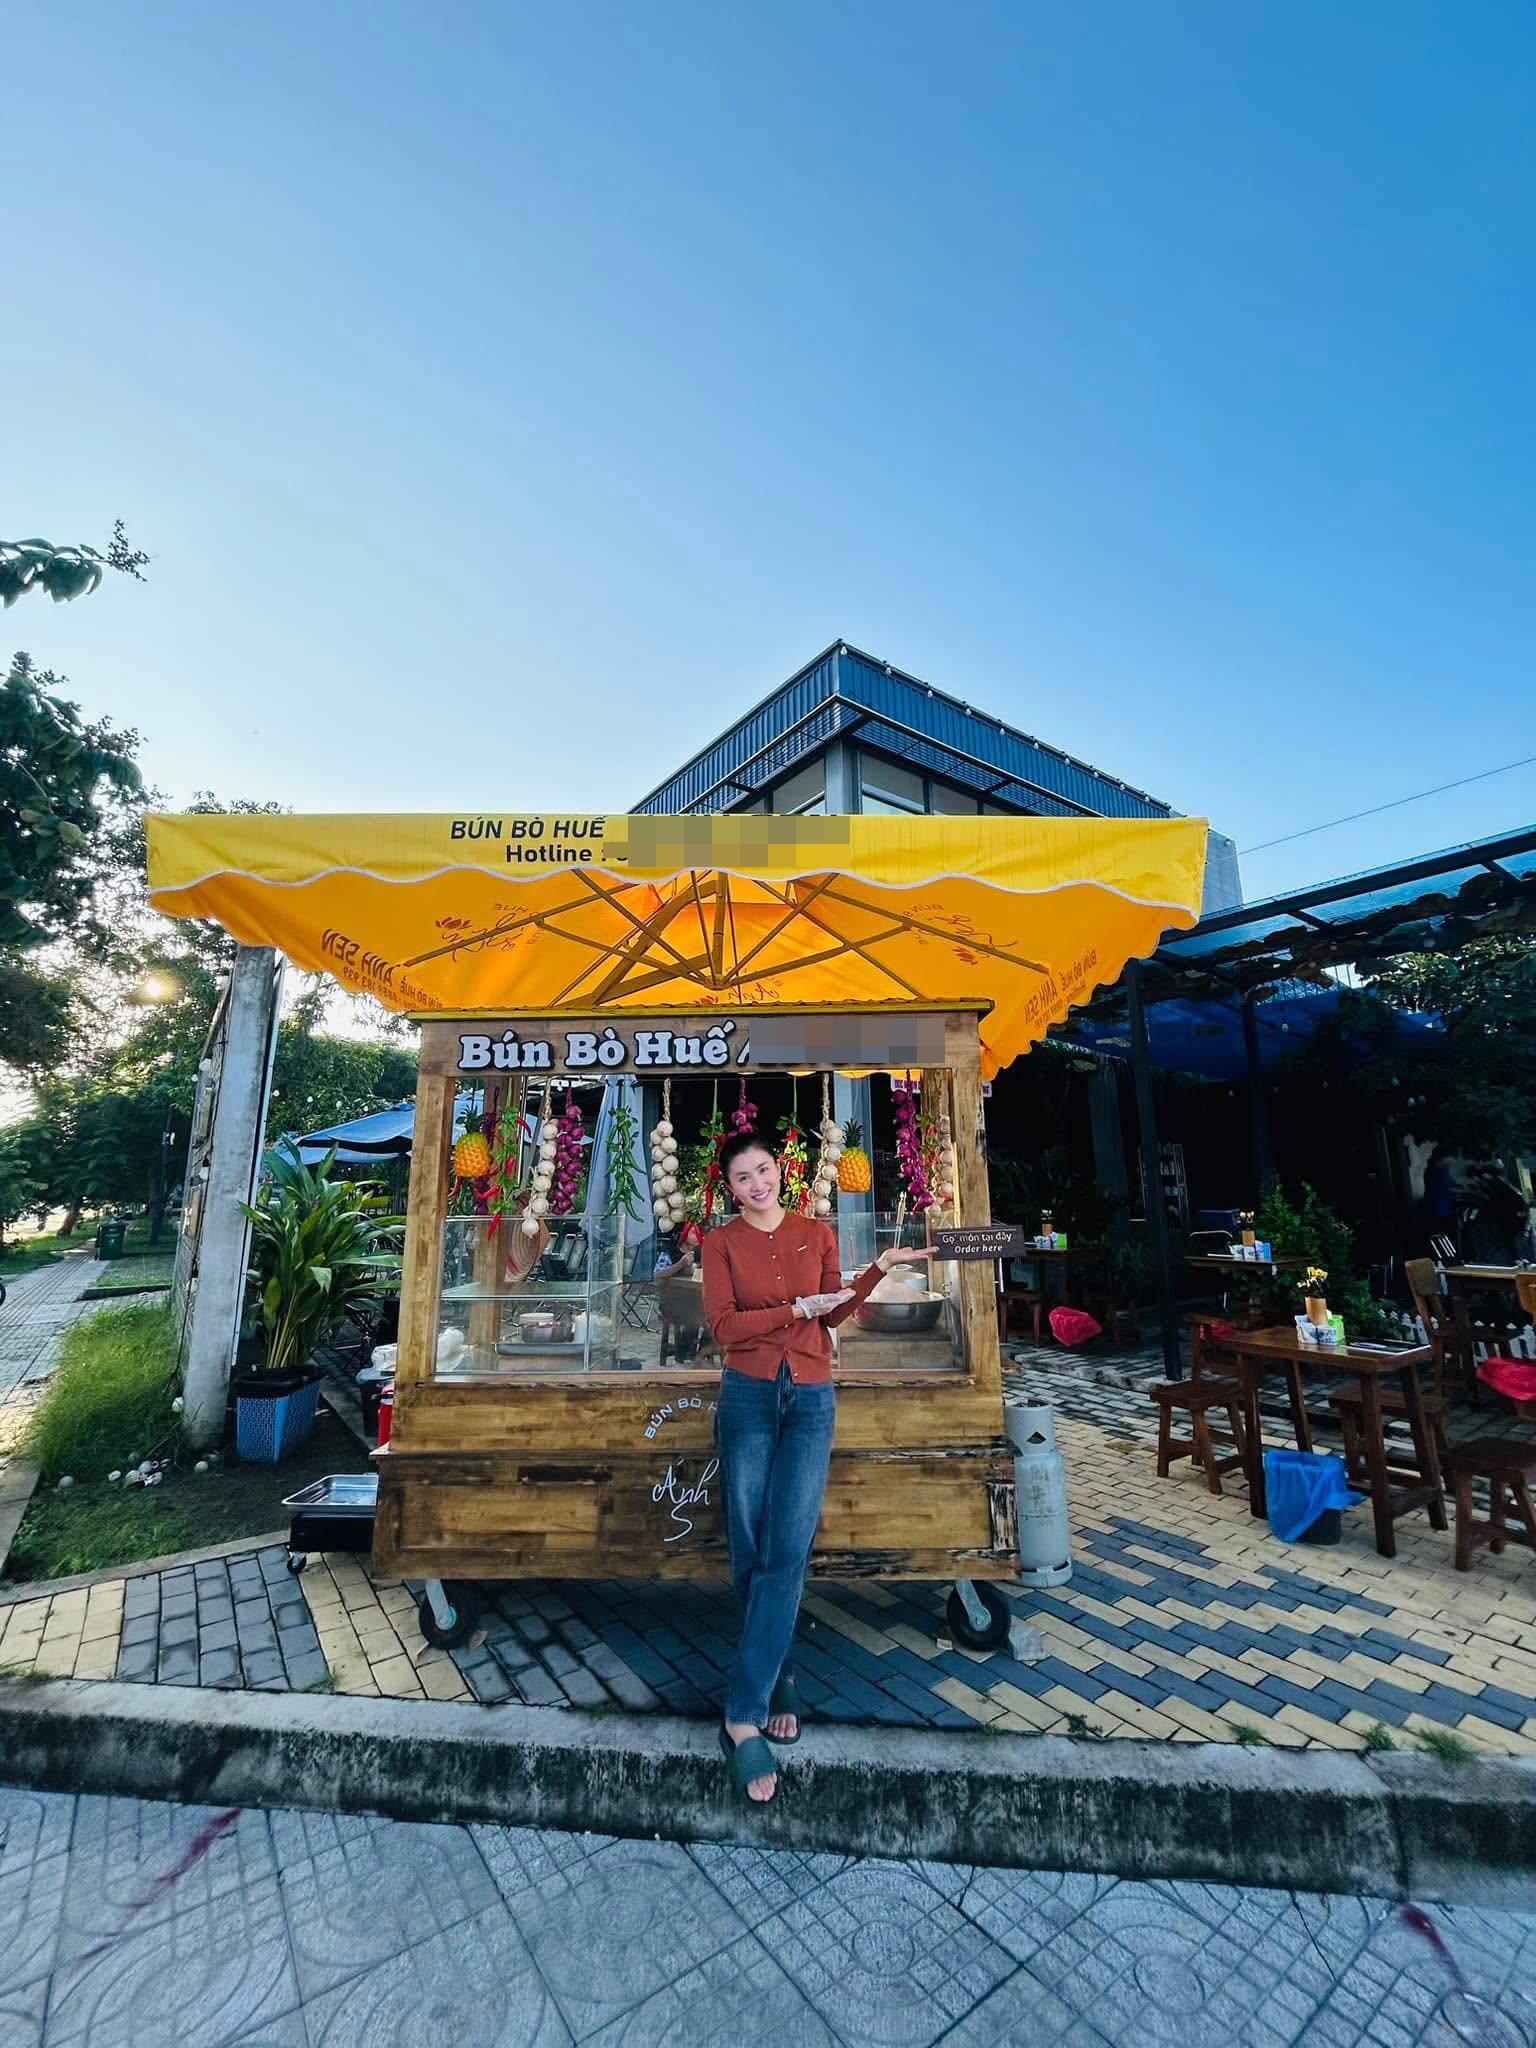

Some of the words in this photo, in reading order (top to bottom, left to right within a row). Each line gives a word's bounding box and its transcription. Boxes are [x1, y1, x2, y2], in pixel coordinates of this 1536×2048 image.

[451, 817, 502, 839] BÚN
[511, 817, 544, 839] BÒ
[506, 845, 592, 862] Hotline
[458, 1029, 554, 1070] Bún
[564, 1026, 626, 1067] Bò
[633, 1020, 736, 1066] Huế
[954, 1244, 980, 1253] Order
[982, 1244, 1003, 1252] here
[644, 1403, 673, 1440] BÚN
